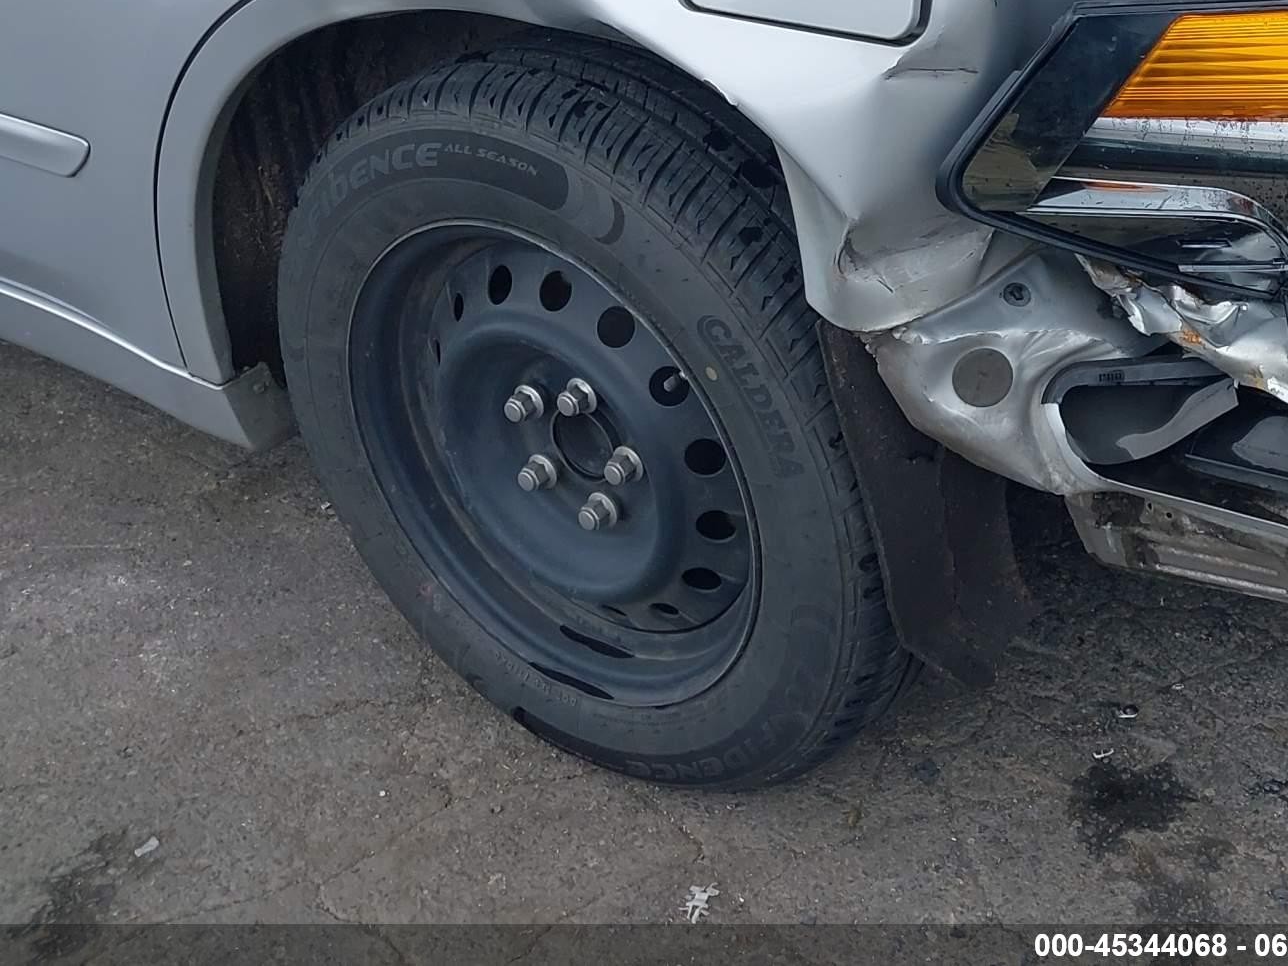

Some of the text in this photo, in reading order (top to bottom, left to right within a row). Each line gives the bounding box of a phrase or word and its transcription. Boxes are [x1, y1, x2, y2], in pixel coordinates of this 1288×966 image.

[444, 143, 472, 155] ALL
[476, 148, 537, 176] SEASON
[698, 315, 806, 478] CALDERA
